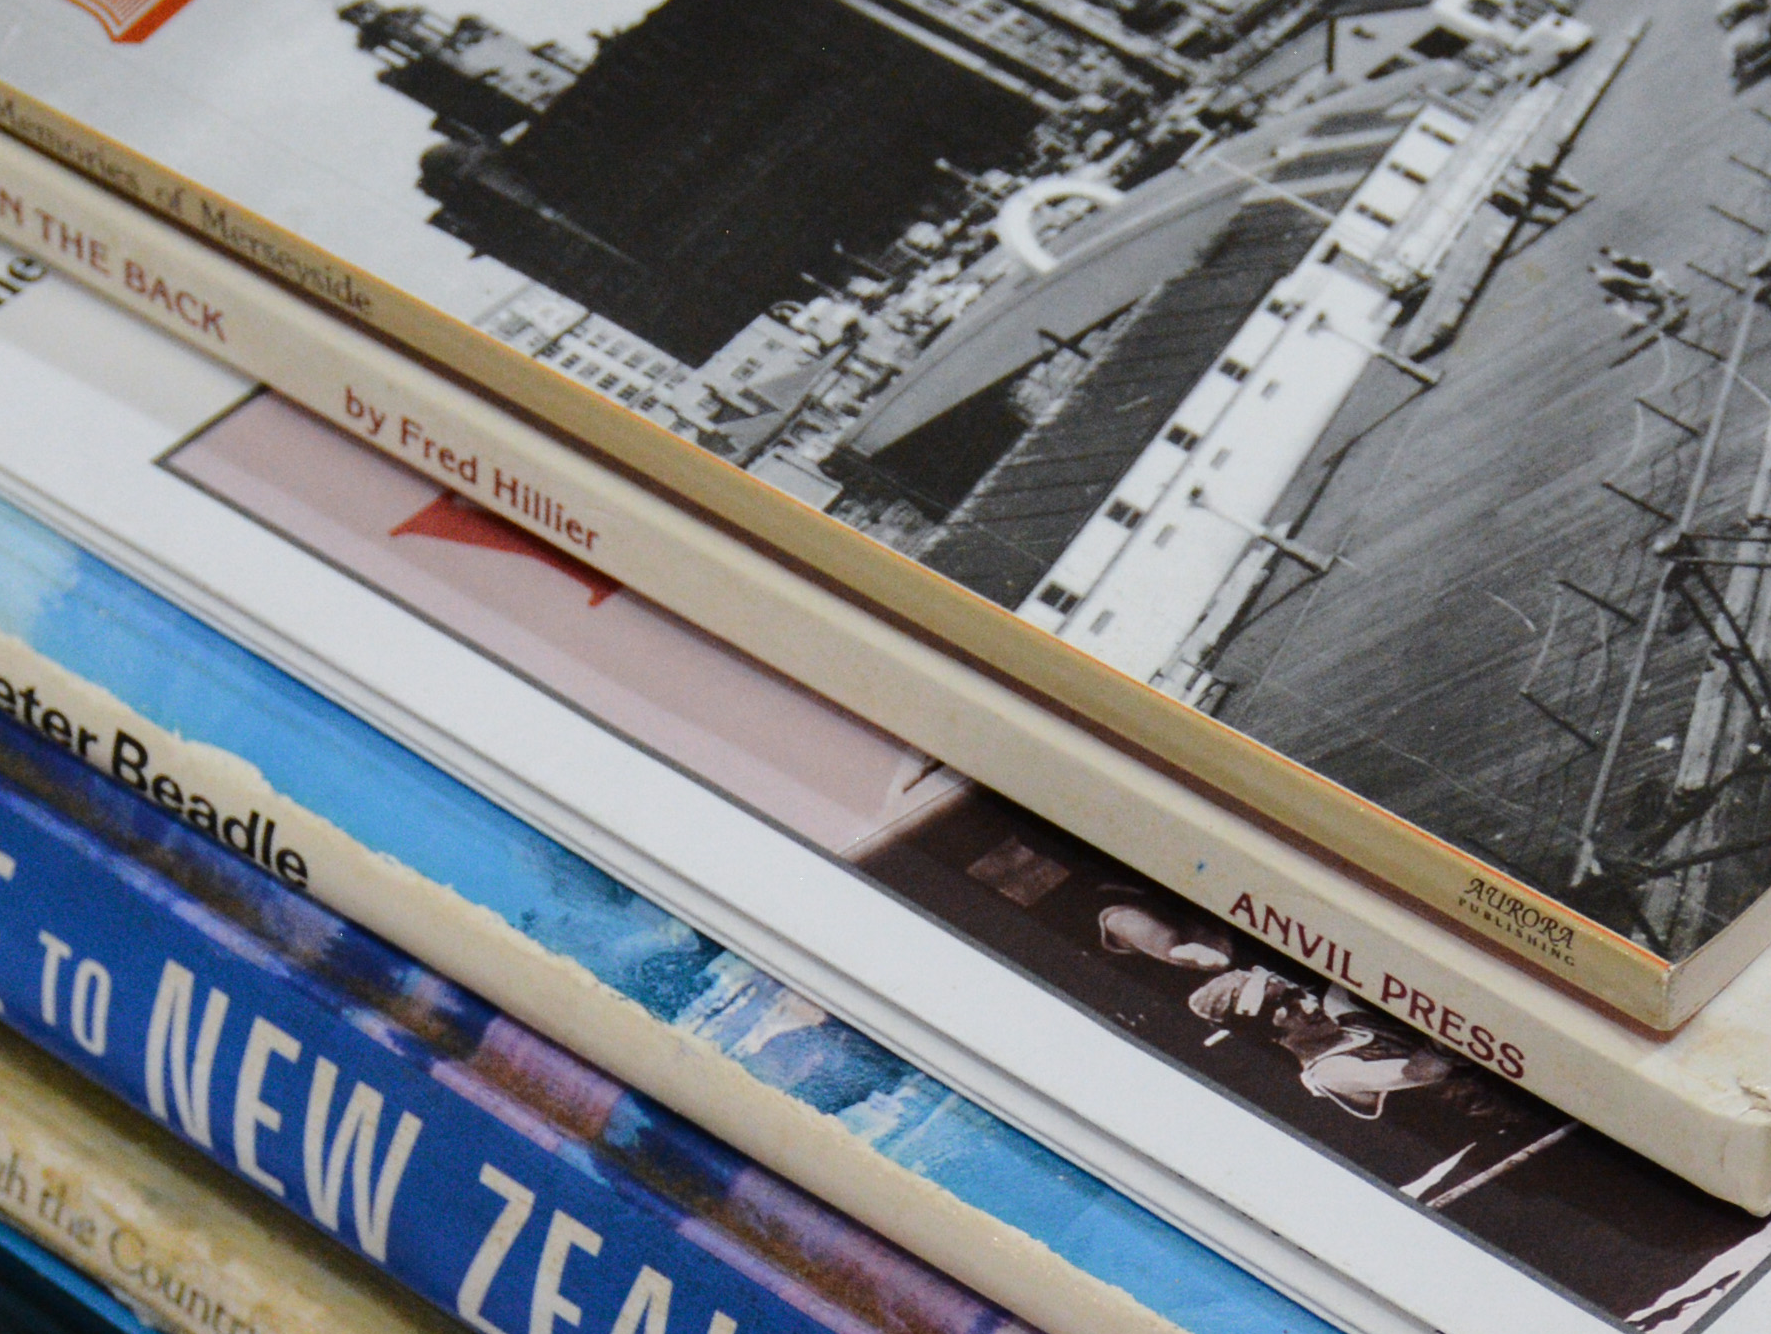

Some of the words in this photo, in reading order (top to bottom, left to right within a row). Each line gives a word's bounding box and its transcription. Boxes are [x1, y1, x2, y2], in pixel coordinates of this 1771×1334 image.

[35, 206, 112, 280] THE
[123, 259, 228, 343] BACK
[153, 182, 182, 216] of
[200, 199, 374, 313] Merseyside
[344, 385, 386, 436] by
[399, 414, 479, 486] Fred
[493, 467, 601, 552] Hillier
[112, 728, 310, 889] Beadle
[1457, 895, 1576, 967] PUBLISHING
[1463, 877, 1576, 950] AURORA
[1229, 892, 1364, 989] ANVIL
[1379, 970, 1526, 1081] PRESS
[38, 929, 113, 1058] TO
[144, 958, 424, 1267] NEW
[36, 1184, 99, 1248] the
